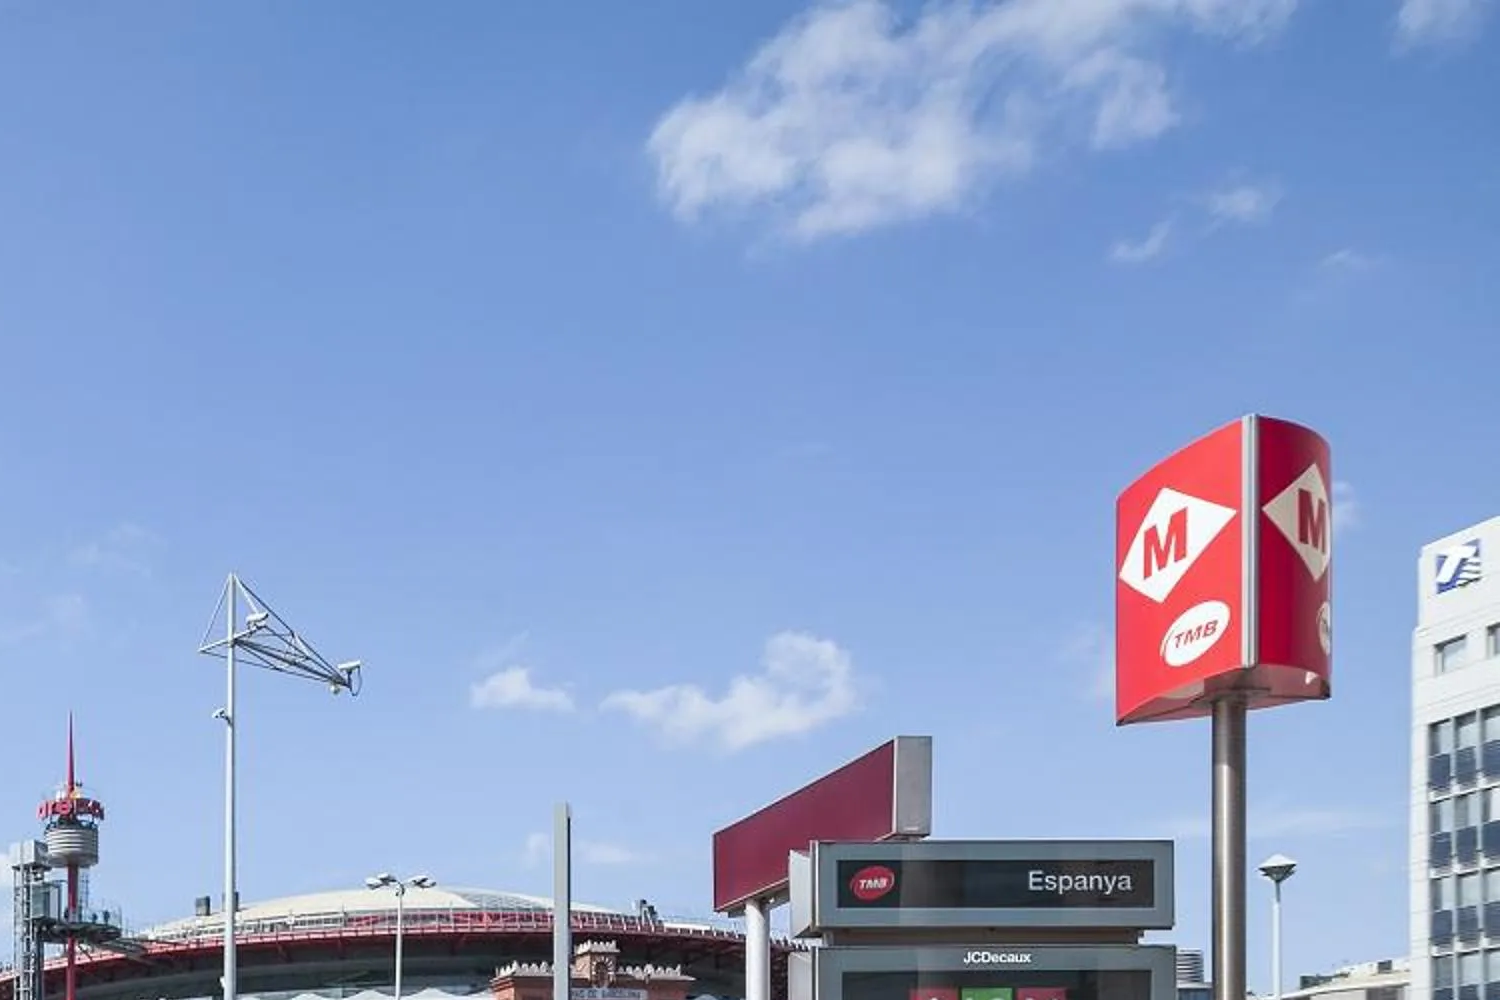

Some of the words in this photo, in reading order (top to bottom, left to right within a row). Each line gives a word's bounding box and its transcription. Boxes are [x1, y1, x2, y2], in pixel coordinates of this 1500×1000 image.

[1298, 487, 1326, 555] M
[1143, 506, 1189, 581] M
[1173, 618, 1219, 650] TMB
[858, 878, 888, 890] TMB
[1028, 870, 1132, 895] Espanya
[963, 951, 1032, 964] JCDecaux
